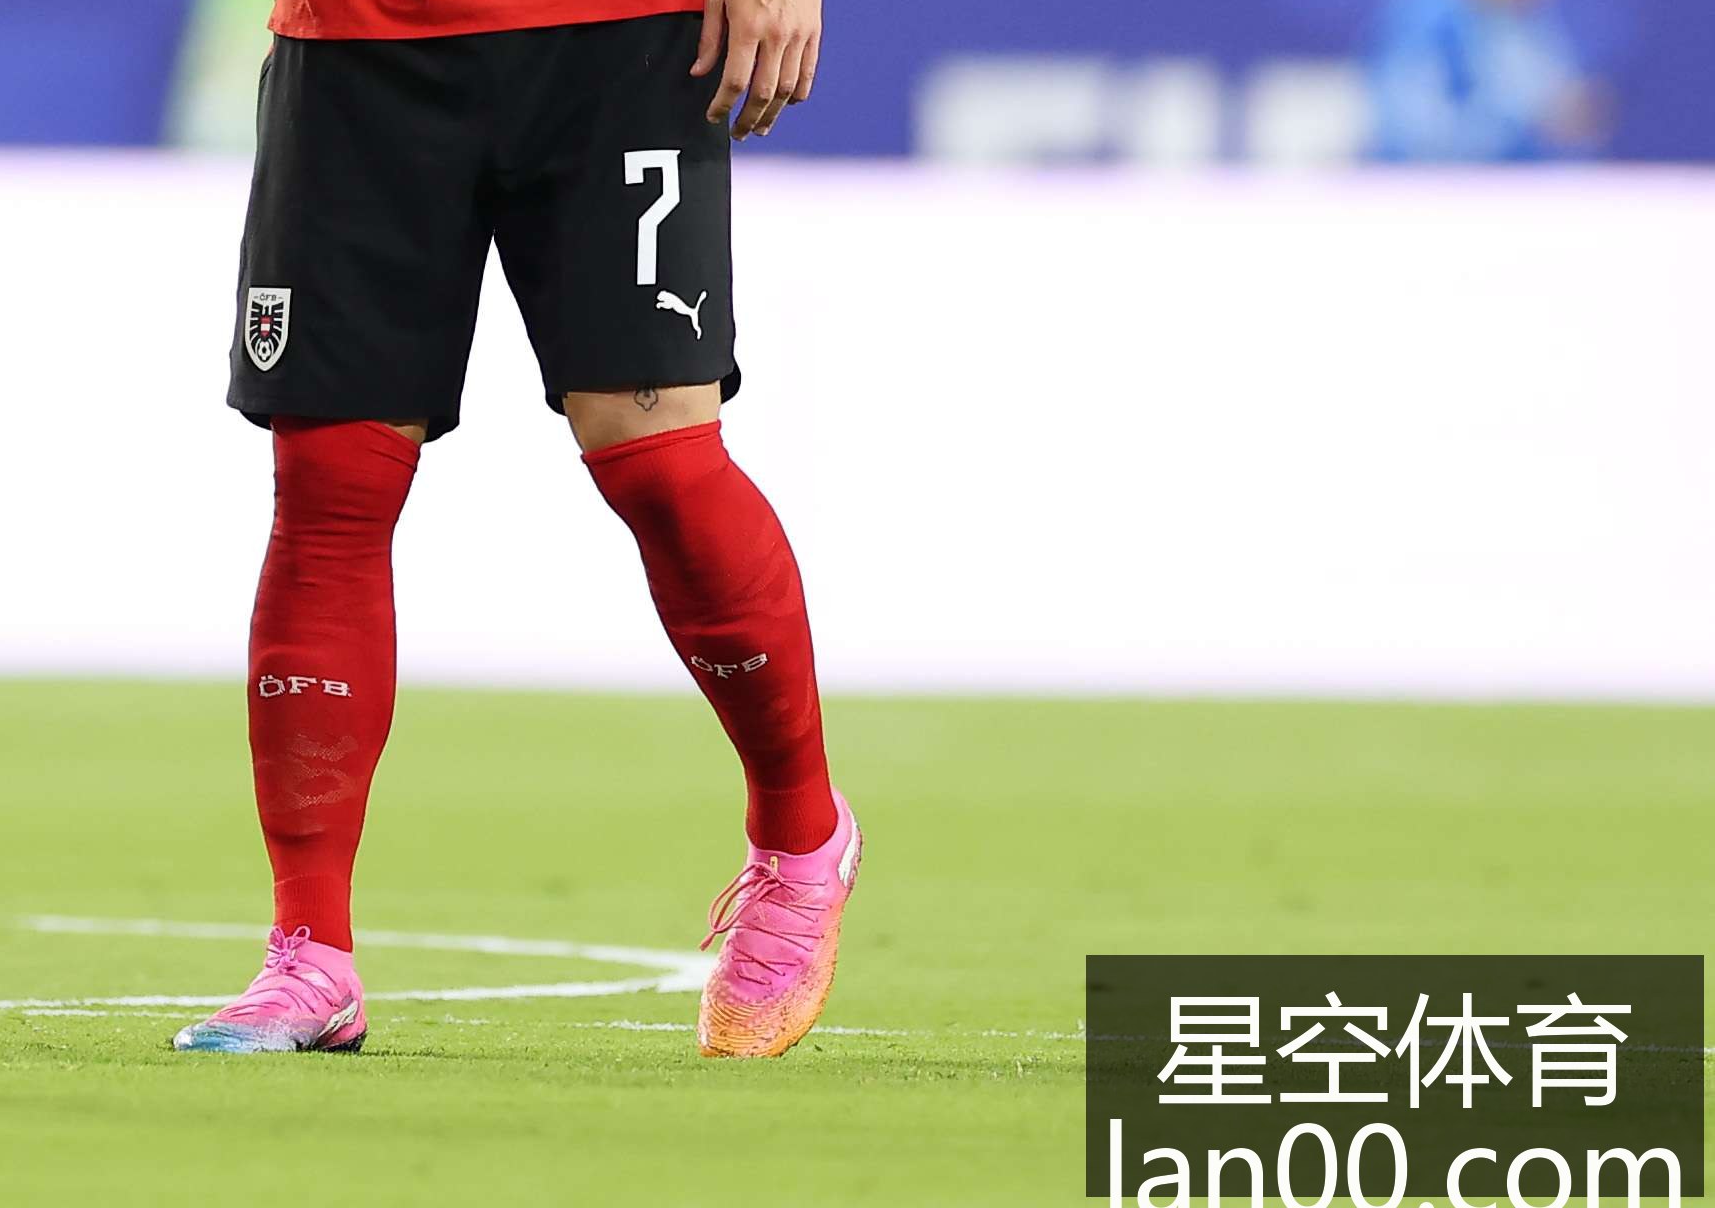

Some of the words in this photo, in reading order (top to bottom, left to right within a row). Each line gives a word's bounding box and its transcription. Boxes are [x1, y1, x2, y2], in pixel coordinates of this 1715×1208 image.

[624, 149, 681, 285] 7
[690, 653, 768, 679] ÖFB
[259, 675, 349, 697] ÖFB
